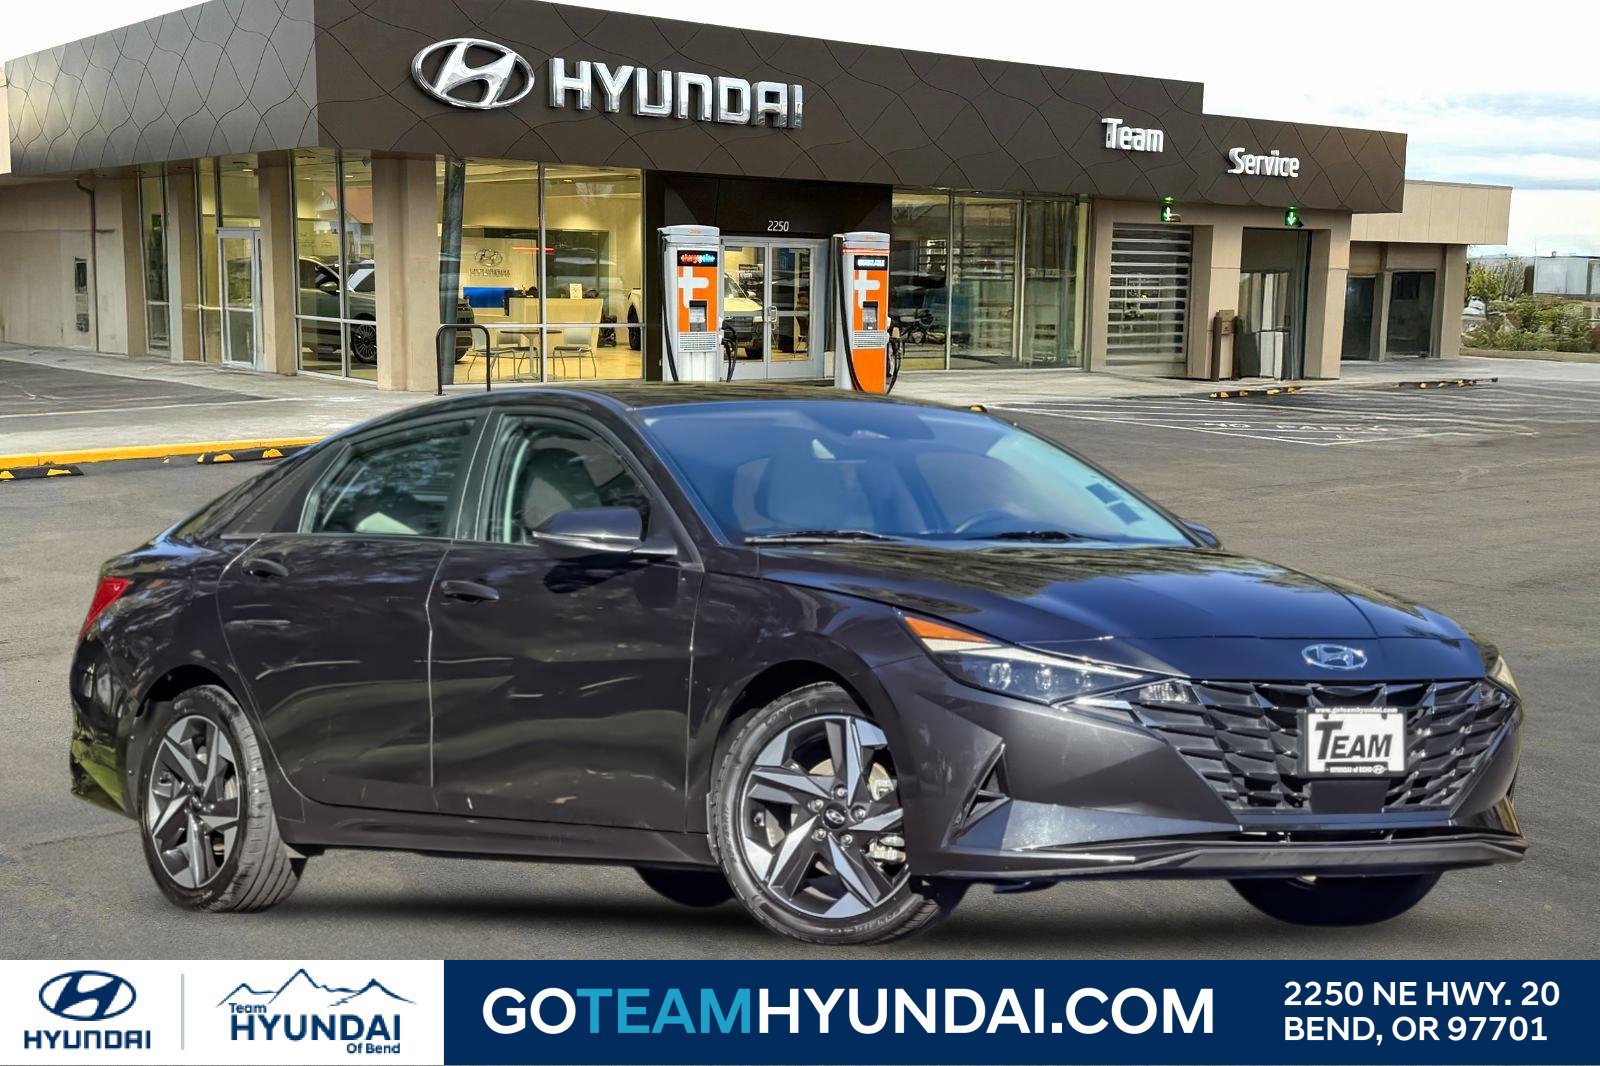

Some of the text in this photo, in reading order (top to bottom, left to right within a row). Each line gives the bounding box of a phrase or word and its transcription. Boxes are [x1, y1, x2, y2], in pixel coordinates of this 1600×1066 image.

[549, 57, 804, 129] HYUNDAI
[1101, 117, 1164, 153] Team
[1227, 147, 1300, 178] Service
[767, 220, 790, 232] 2250
[1314, 720, 1393, 761] TEAM
